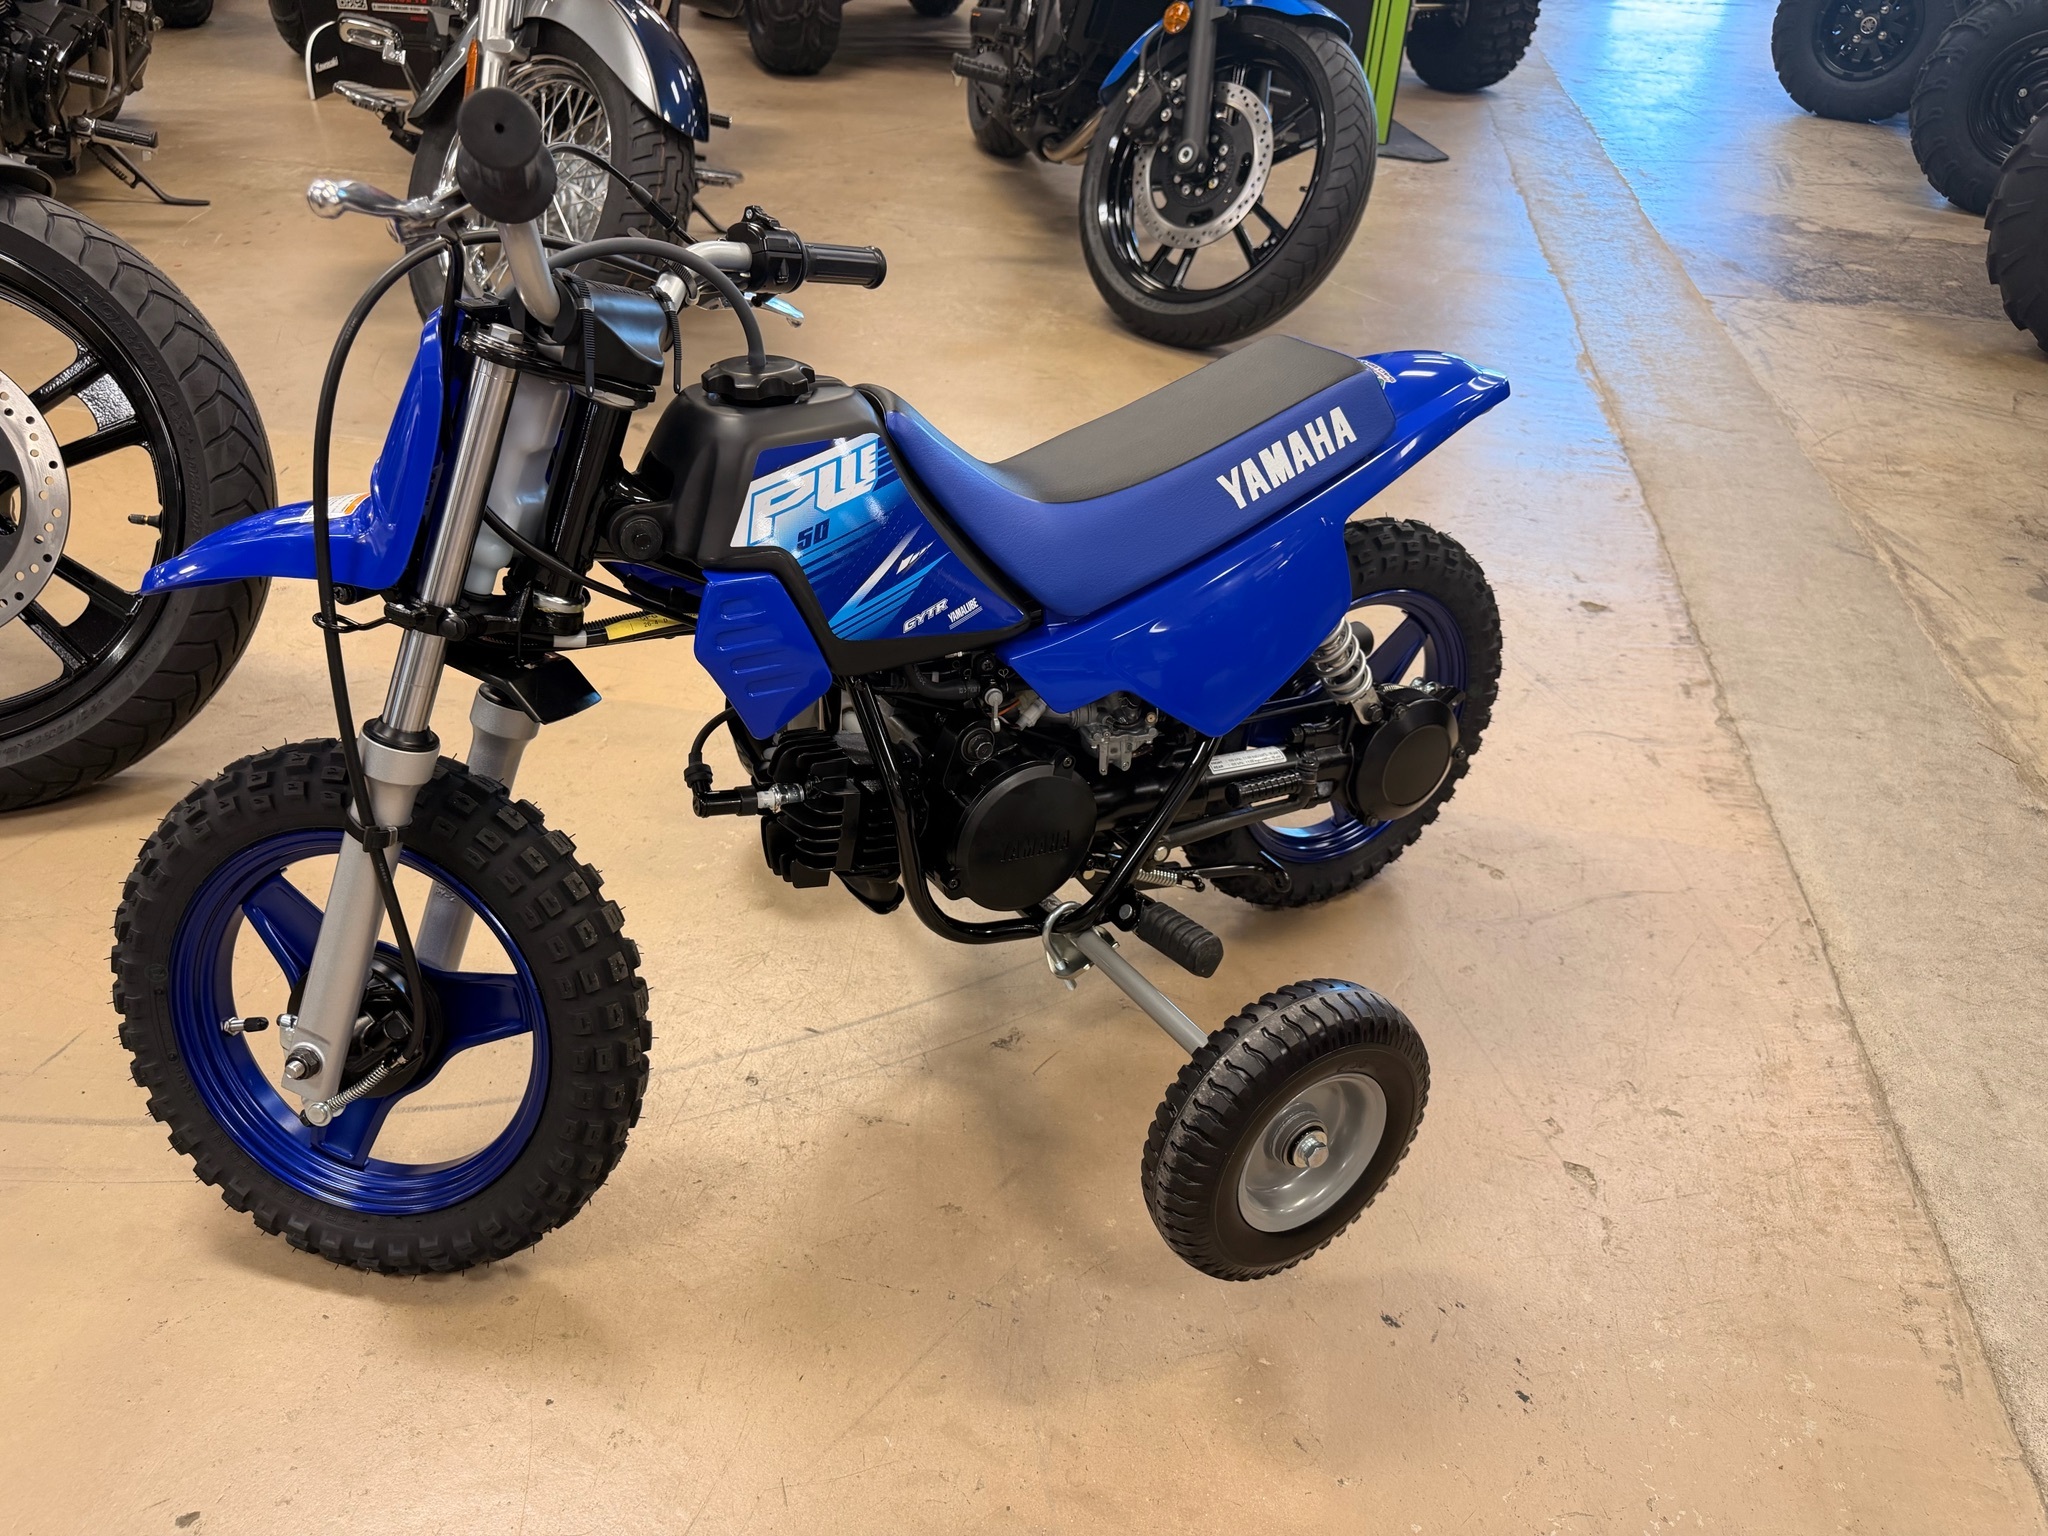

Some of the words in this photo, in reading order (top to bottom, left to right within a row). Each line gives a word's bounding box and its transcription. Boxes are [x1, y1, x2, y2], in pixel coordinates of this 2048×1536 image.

[1216, 406, 1358, 510] YAMAHA
[748, 439, 878, 547] PW
[797, 518, 830, 551] 50
[902, 597, 949, 634] GYTR
[947, 597, 980, 623] YAMALUBE
[1000, 829, 1070, 863] YAMAHA
